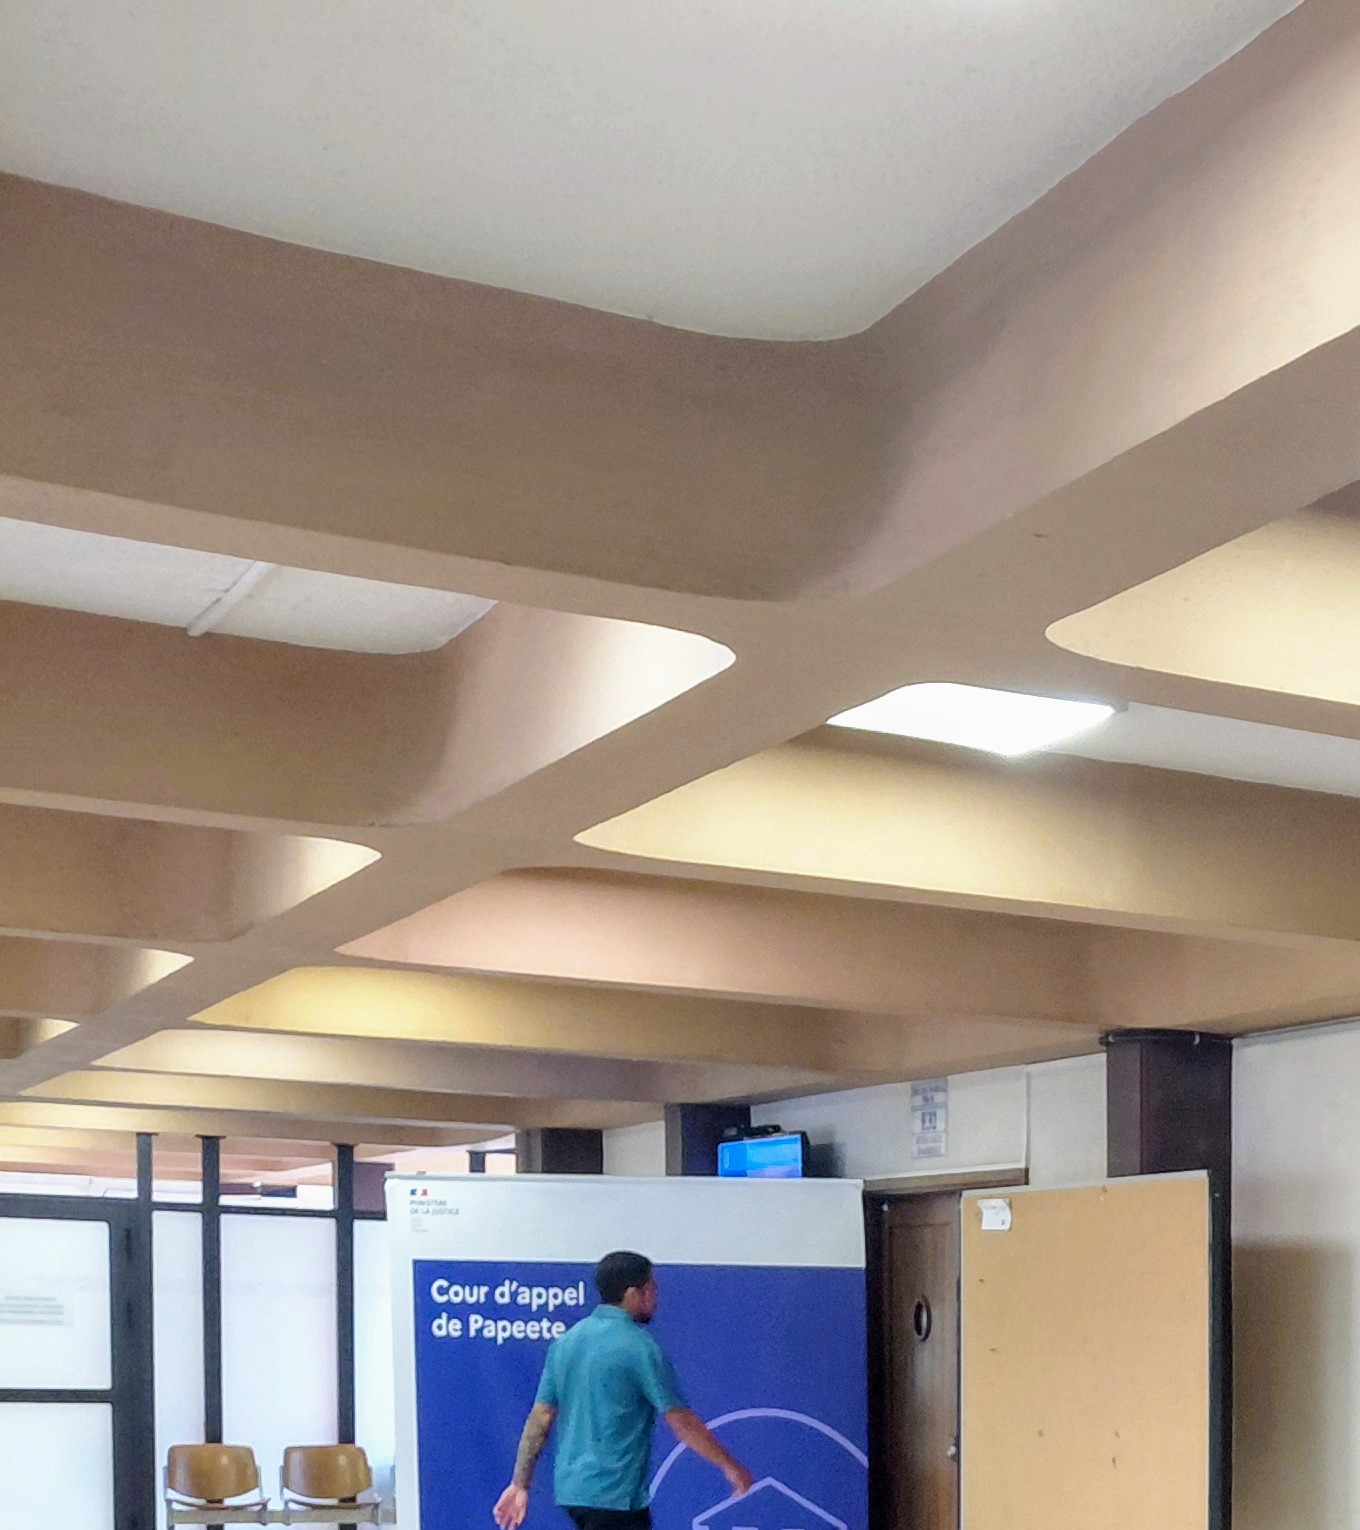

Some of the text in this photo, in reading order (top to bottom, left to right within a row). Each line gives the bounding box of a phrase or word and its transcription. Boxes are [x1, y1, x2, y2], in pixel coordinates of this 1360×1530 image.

[430, 1278, 586, 1312] Cour d'appel
[430, 1312, 568, 1345] de Papeete
